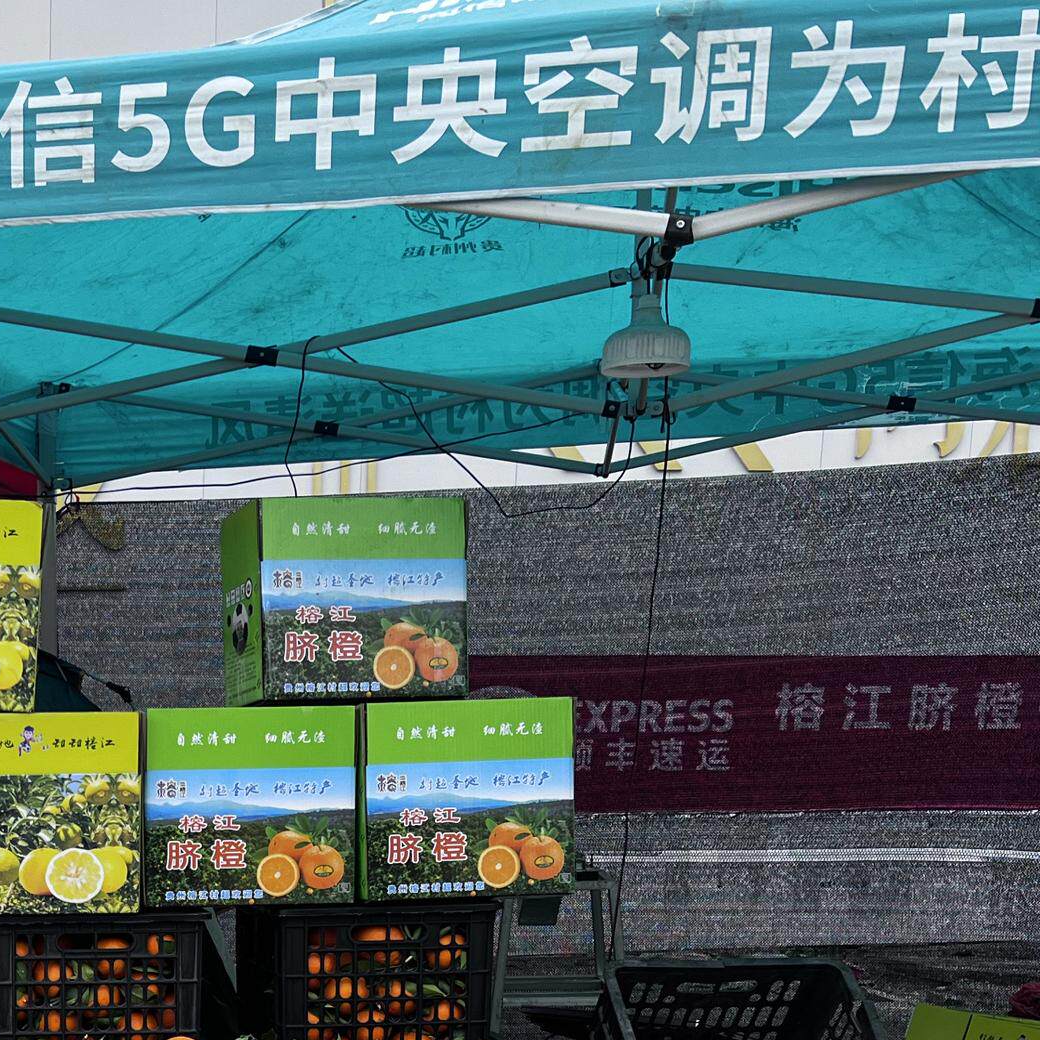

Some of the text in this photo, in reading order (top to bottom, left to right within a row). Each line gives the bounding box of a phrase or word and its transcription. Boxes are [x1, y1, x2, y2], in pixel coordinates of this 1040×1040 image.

[296, 605, 356, 624] 榕江
[284, 631, 363, 662] 脐橙
[776, 682, 1023, 732] 榕江脐橙
[178, 814, 241, 833] 榕江
[400, 807, 461, 827] 榕江
[166, 839, 247, 871] 脐橙
[387, 832, 468, 864] 脐橙
